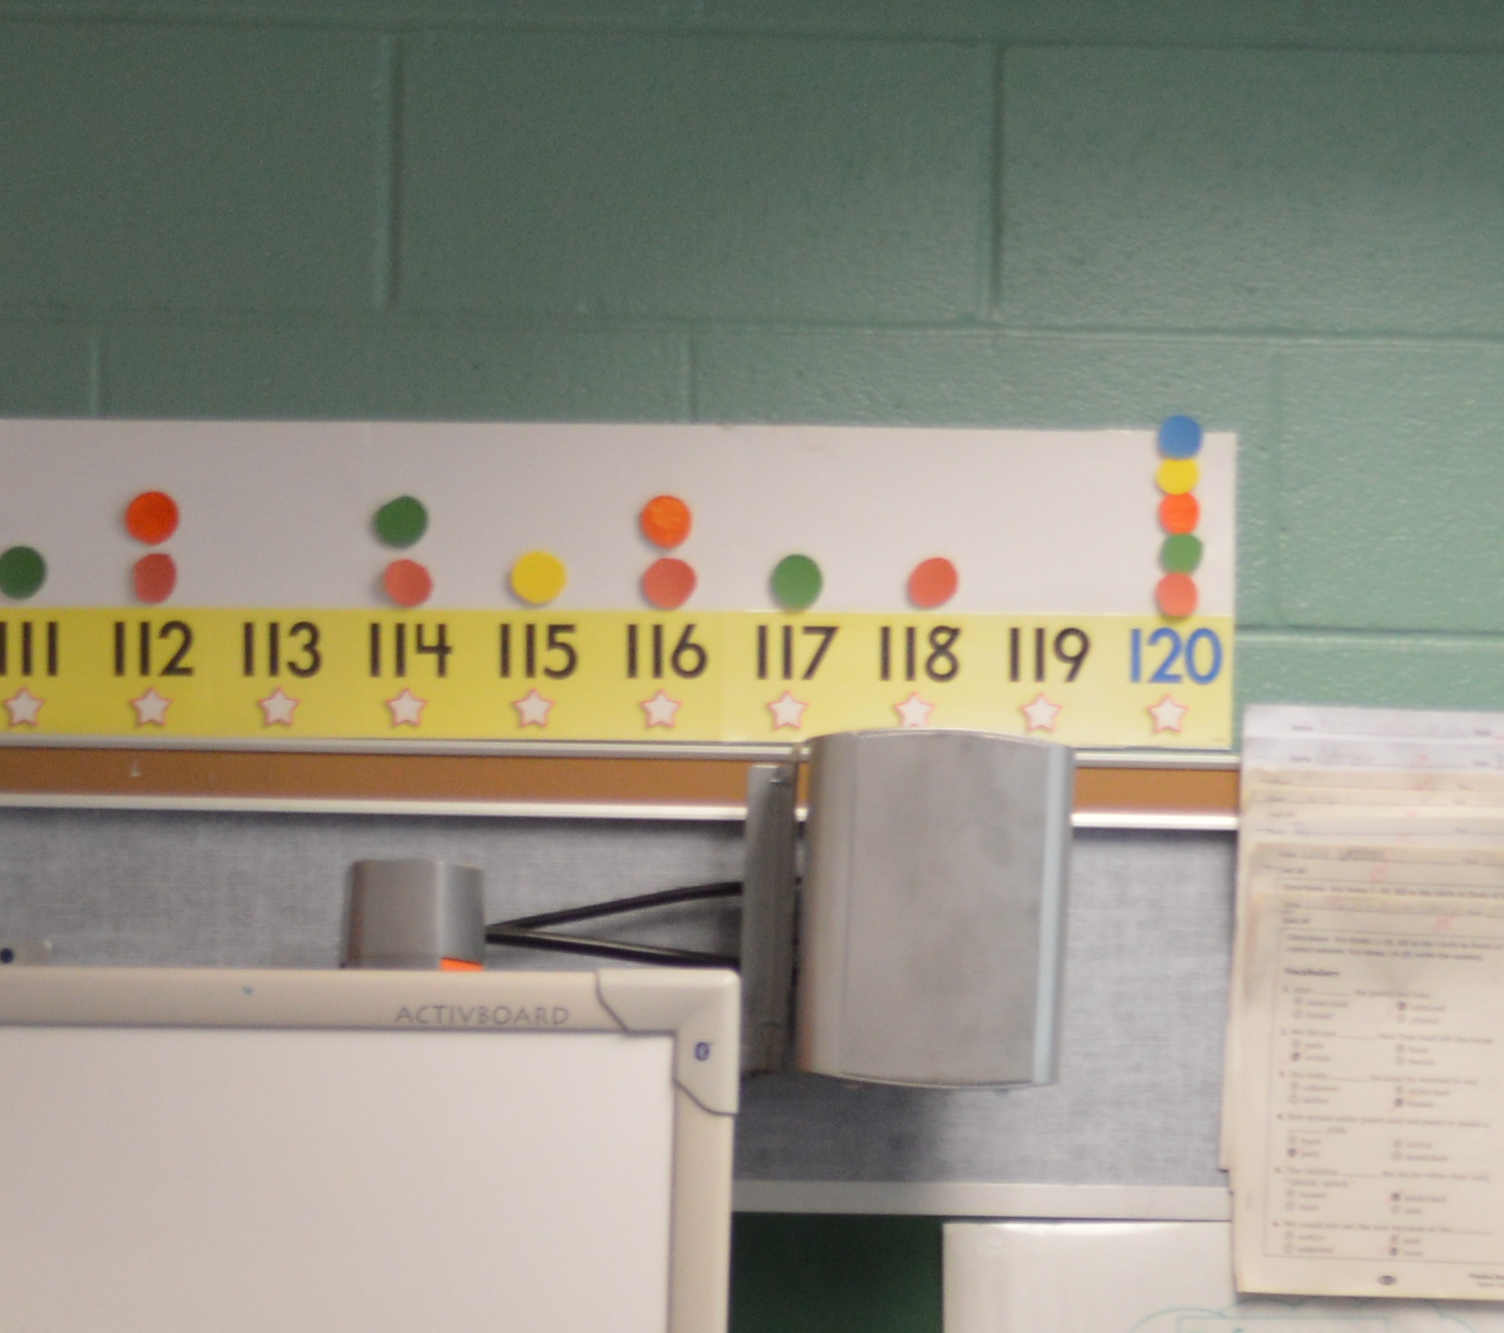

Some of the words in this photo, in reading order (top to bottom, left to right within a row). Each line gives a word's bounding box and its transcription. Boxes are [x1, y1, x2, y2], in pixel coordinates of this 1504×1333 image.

[114, 620, 193, 676] 112
[244, 621, 321, 678] 113
[370, 623, 452, 677] 114
[500, 623, 577, 679] 115
[627, 624, 707, 678] 116
[757, 625, 838, 679] 117
[881, 625, 961, 682] 118
[1010, 627, 1090, 682] 119
[1131, 627, 1223, 685] 120
[397, 1005, 569, 1025] ACTIVBOARD
